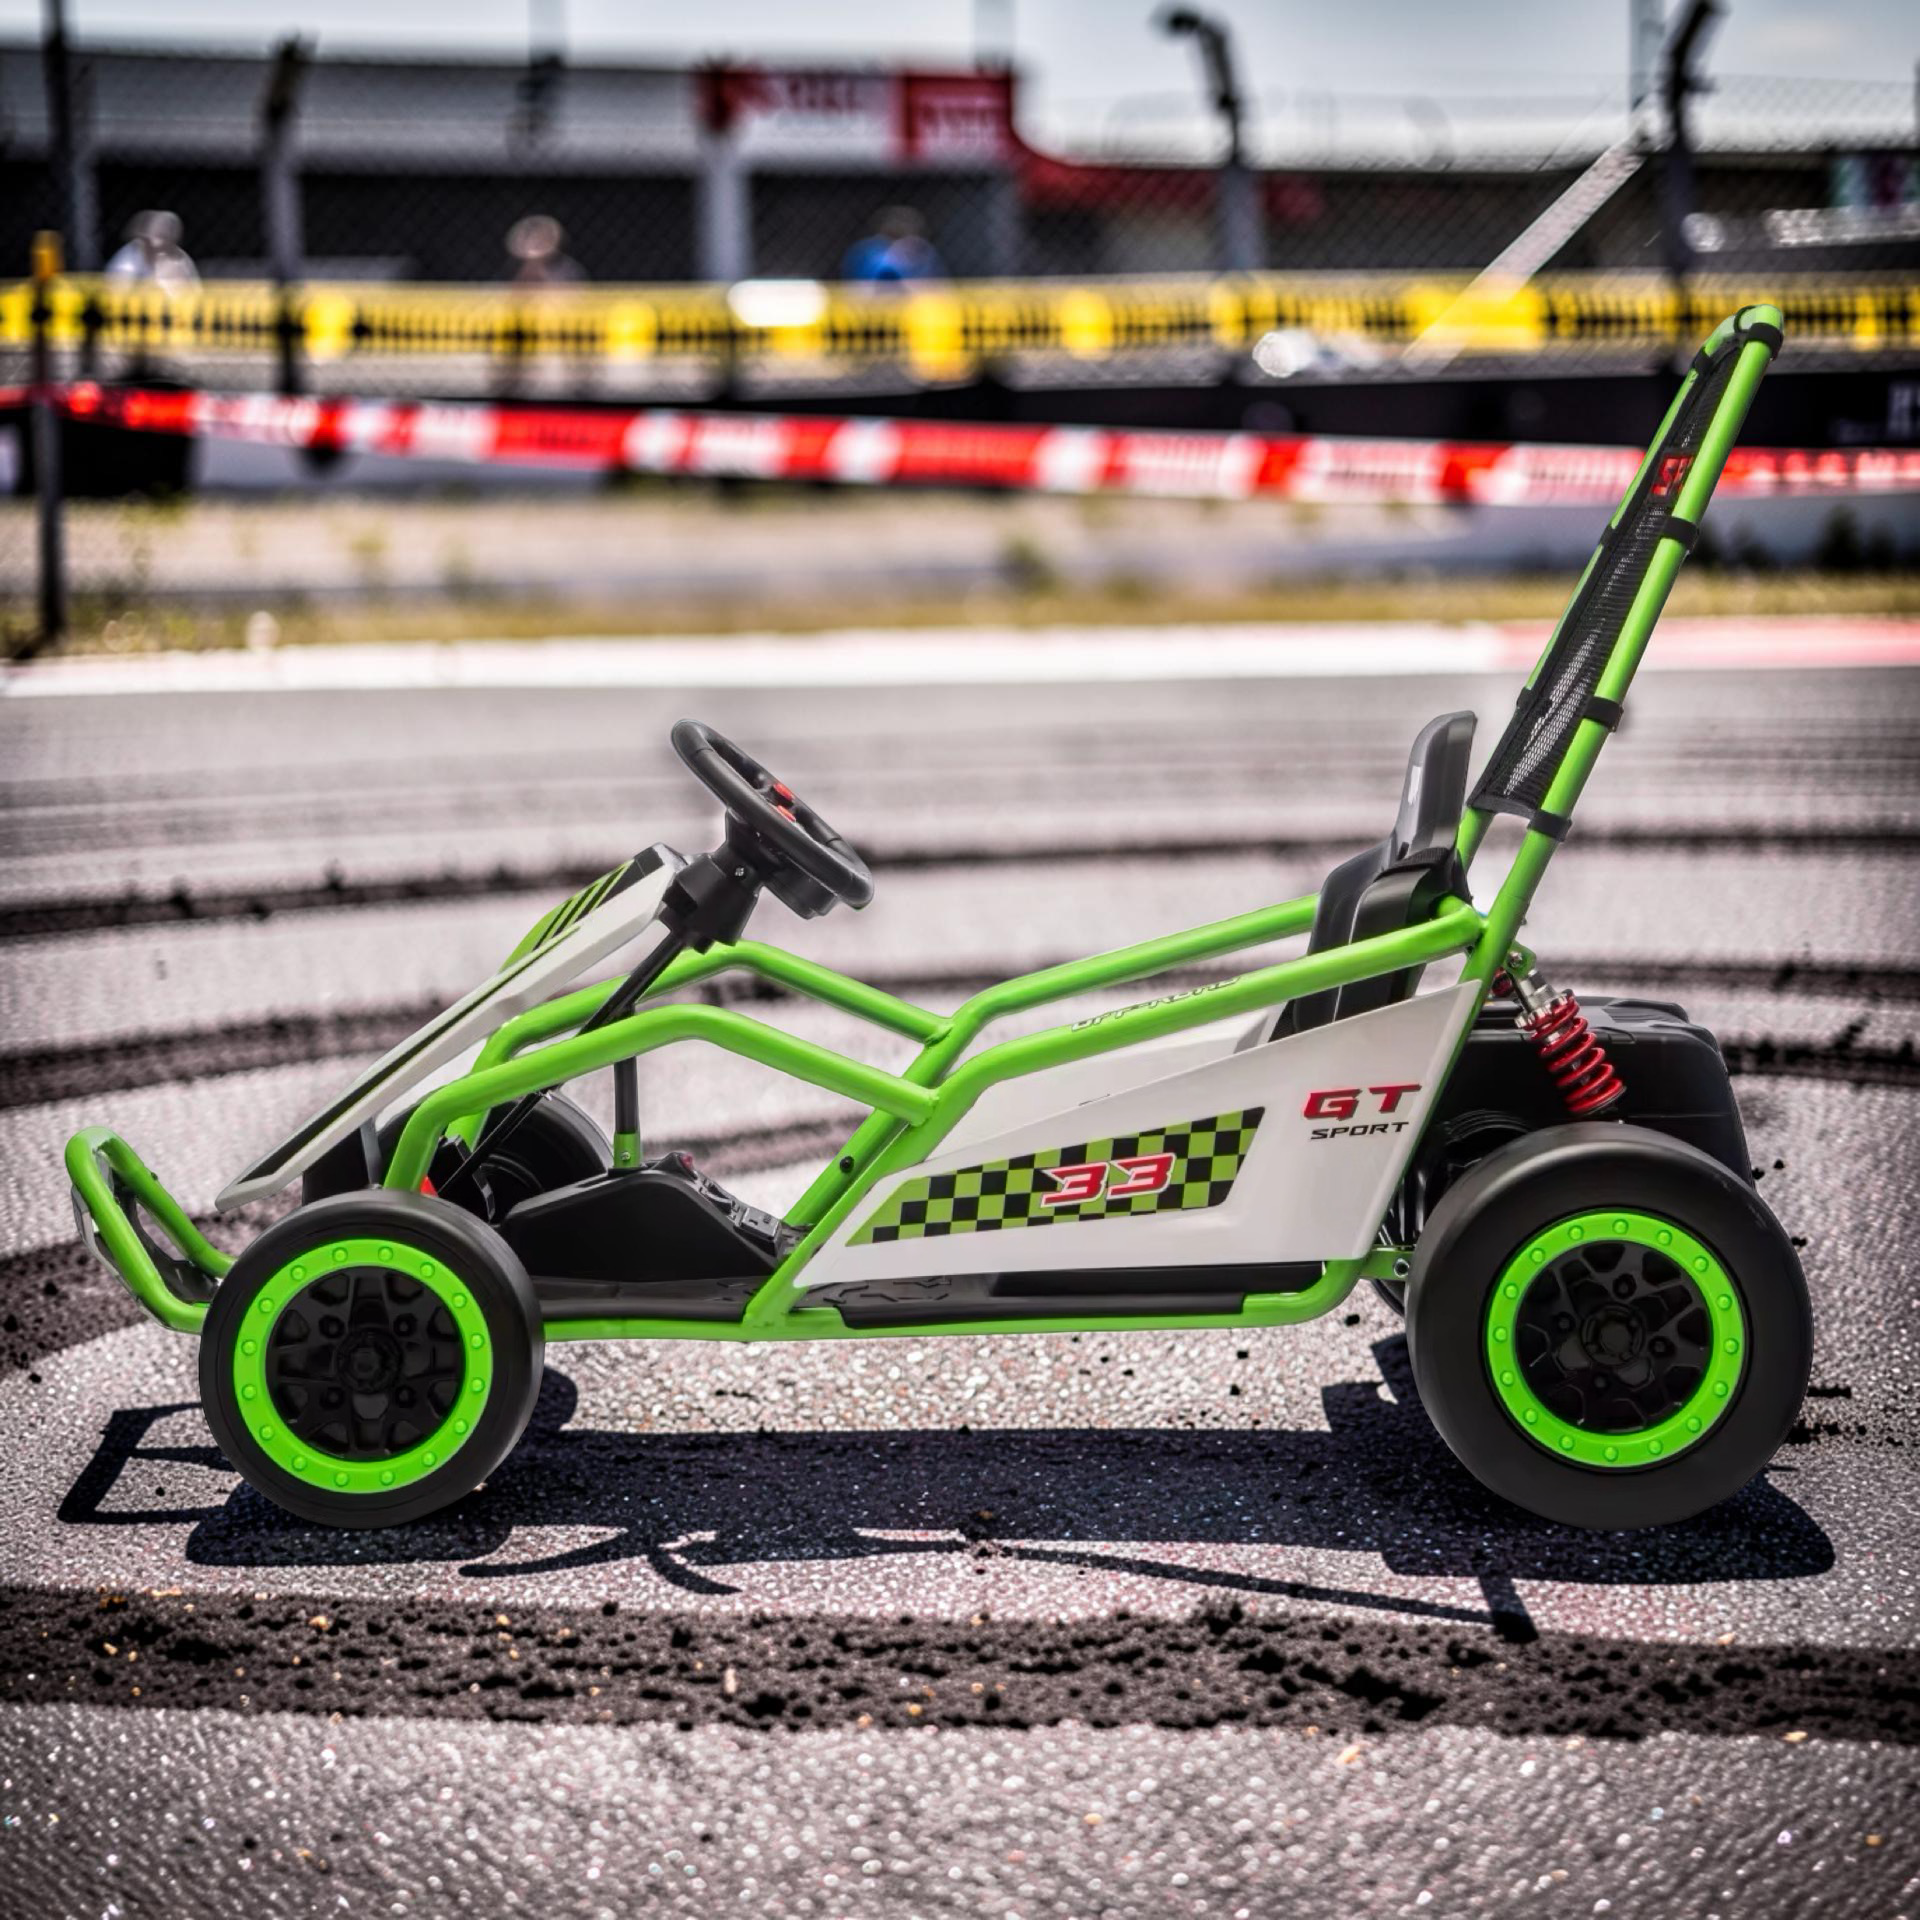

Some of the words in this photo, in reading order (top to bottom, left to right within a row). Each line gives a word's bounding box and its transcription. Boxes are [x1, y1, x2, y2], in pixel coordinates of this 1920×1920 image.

[1303, 1084, 1422, 1121] GT
[1310, 1121, 1409, 1140] SPORT
[1041, 1152, 1176, 1207] 33
